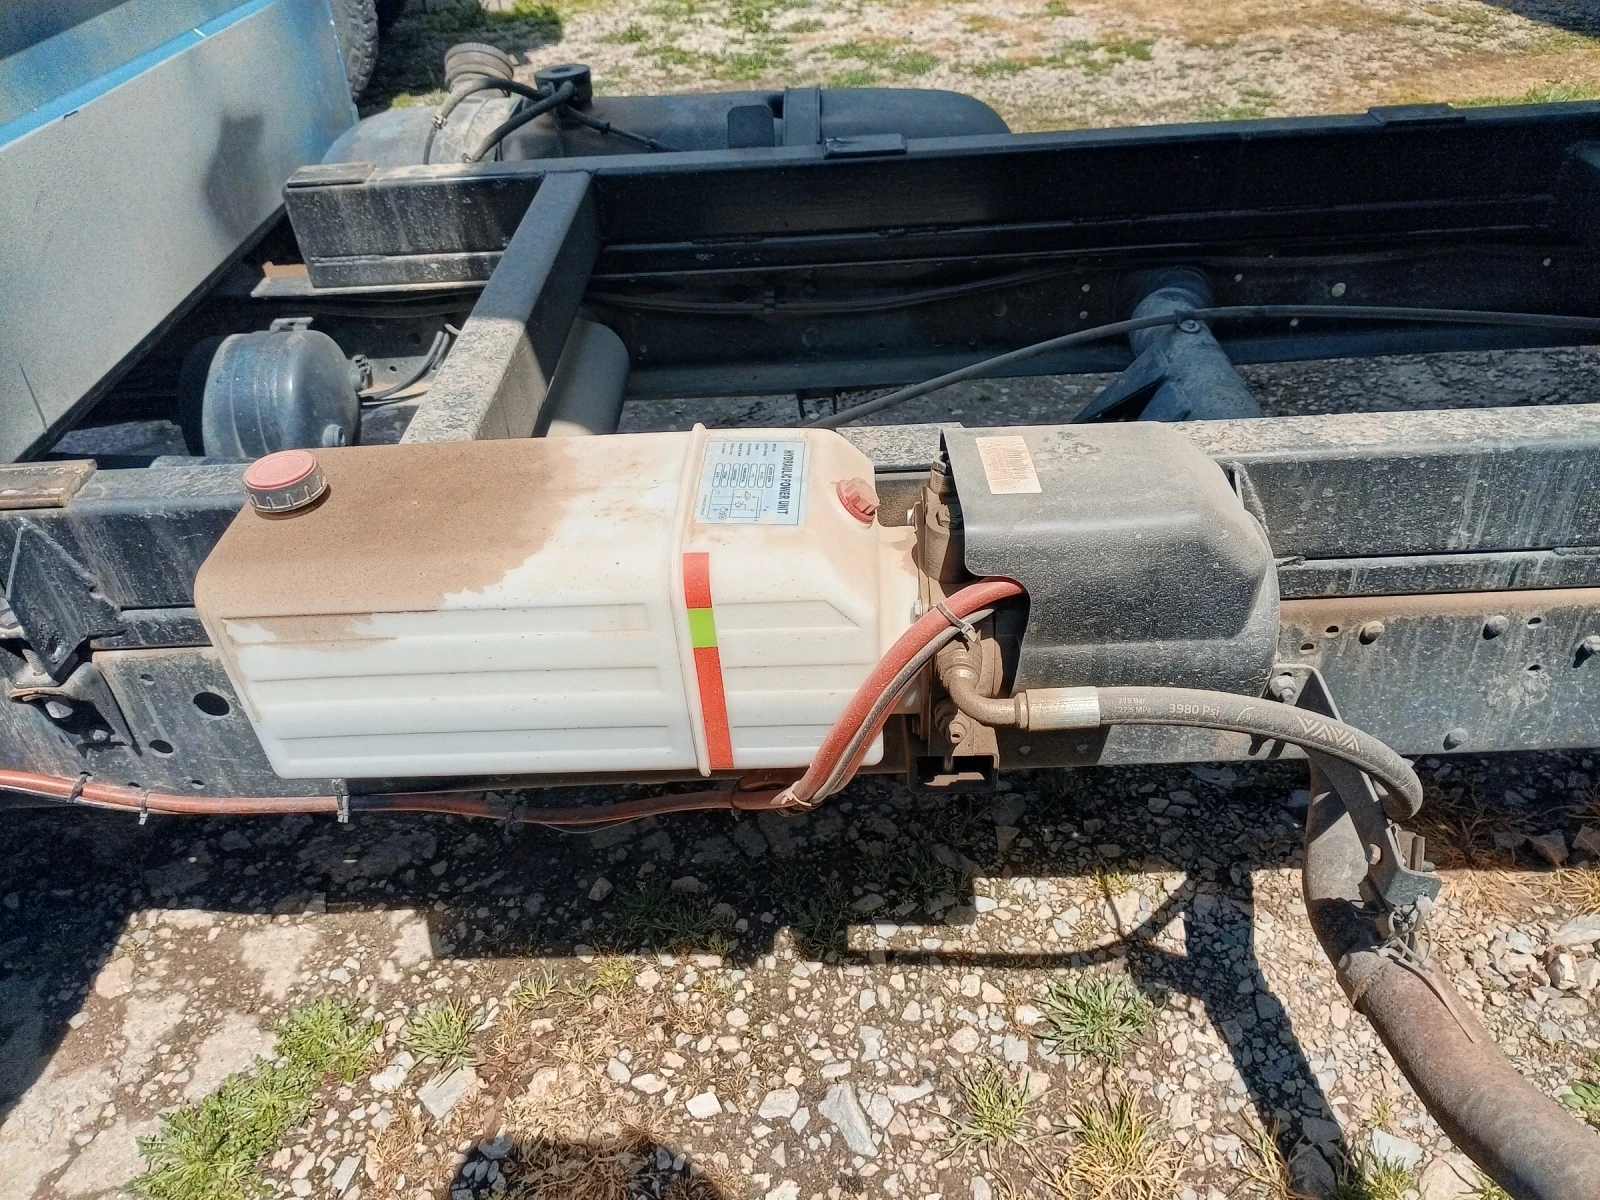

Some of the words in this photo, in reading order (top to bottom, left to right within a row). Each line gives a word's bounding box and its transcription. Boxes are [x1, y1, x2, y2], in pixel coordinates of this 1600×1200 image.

[781, 449, 795, 479] HYDRAULIC
[779, 478, 791, 500] POWER
[777, 499, 790, 515] UNIT
[1133, 697, 1146, 705] Bar
[1168, 703, 1199, 715] 3980
[1202, 705, 1220, 717] Psi
